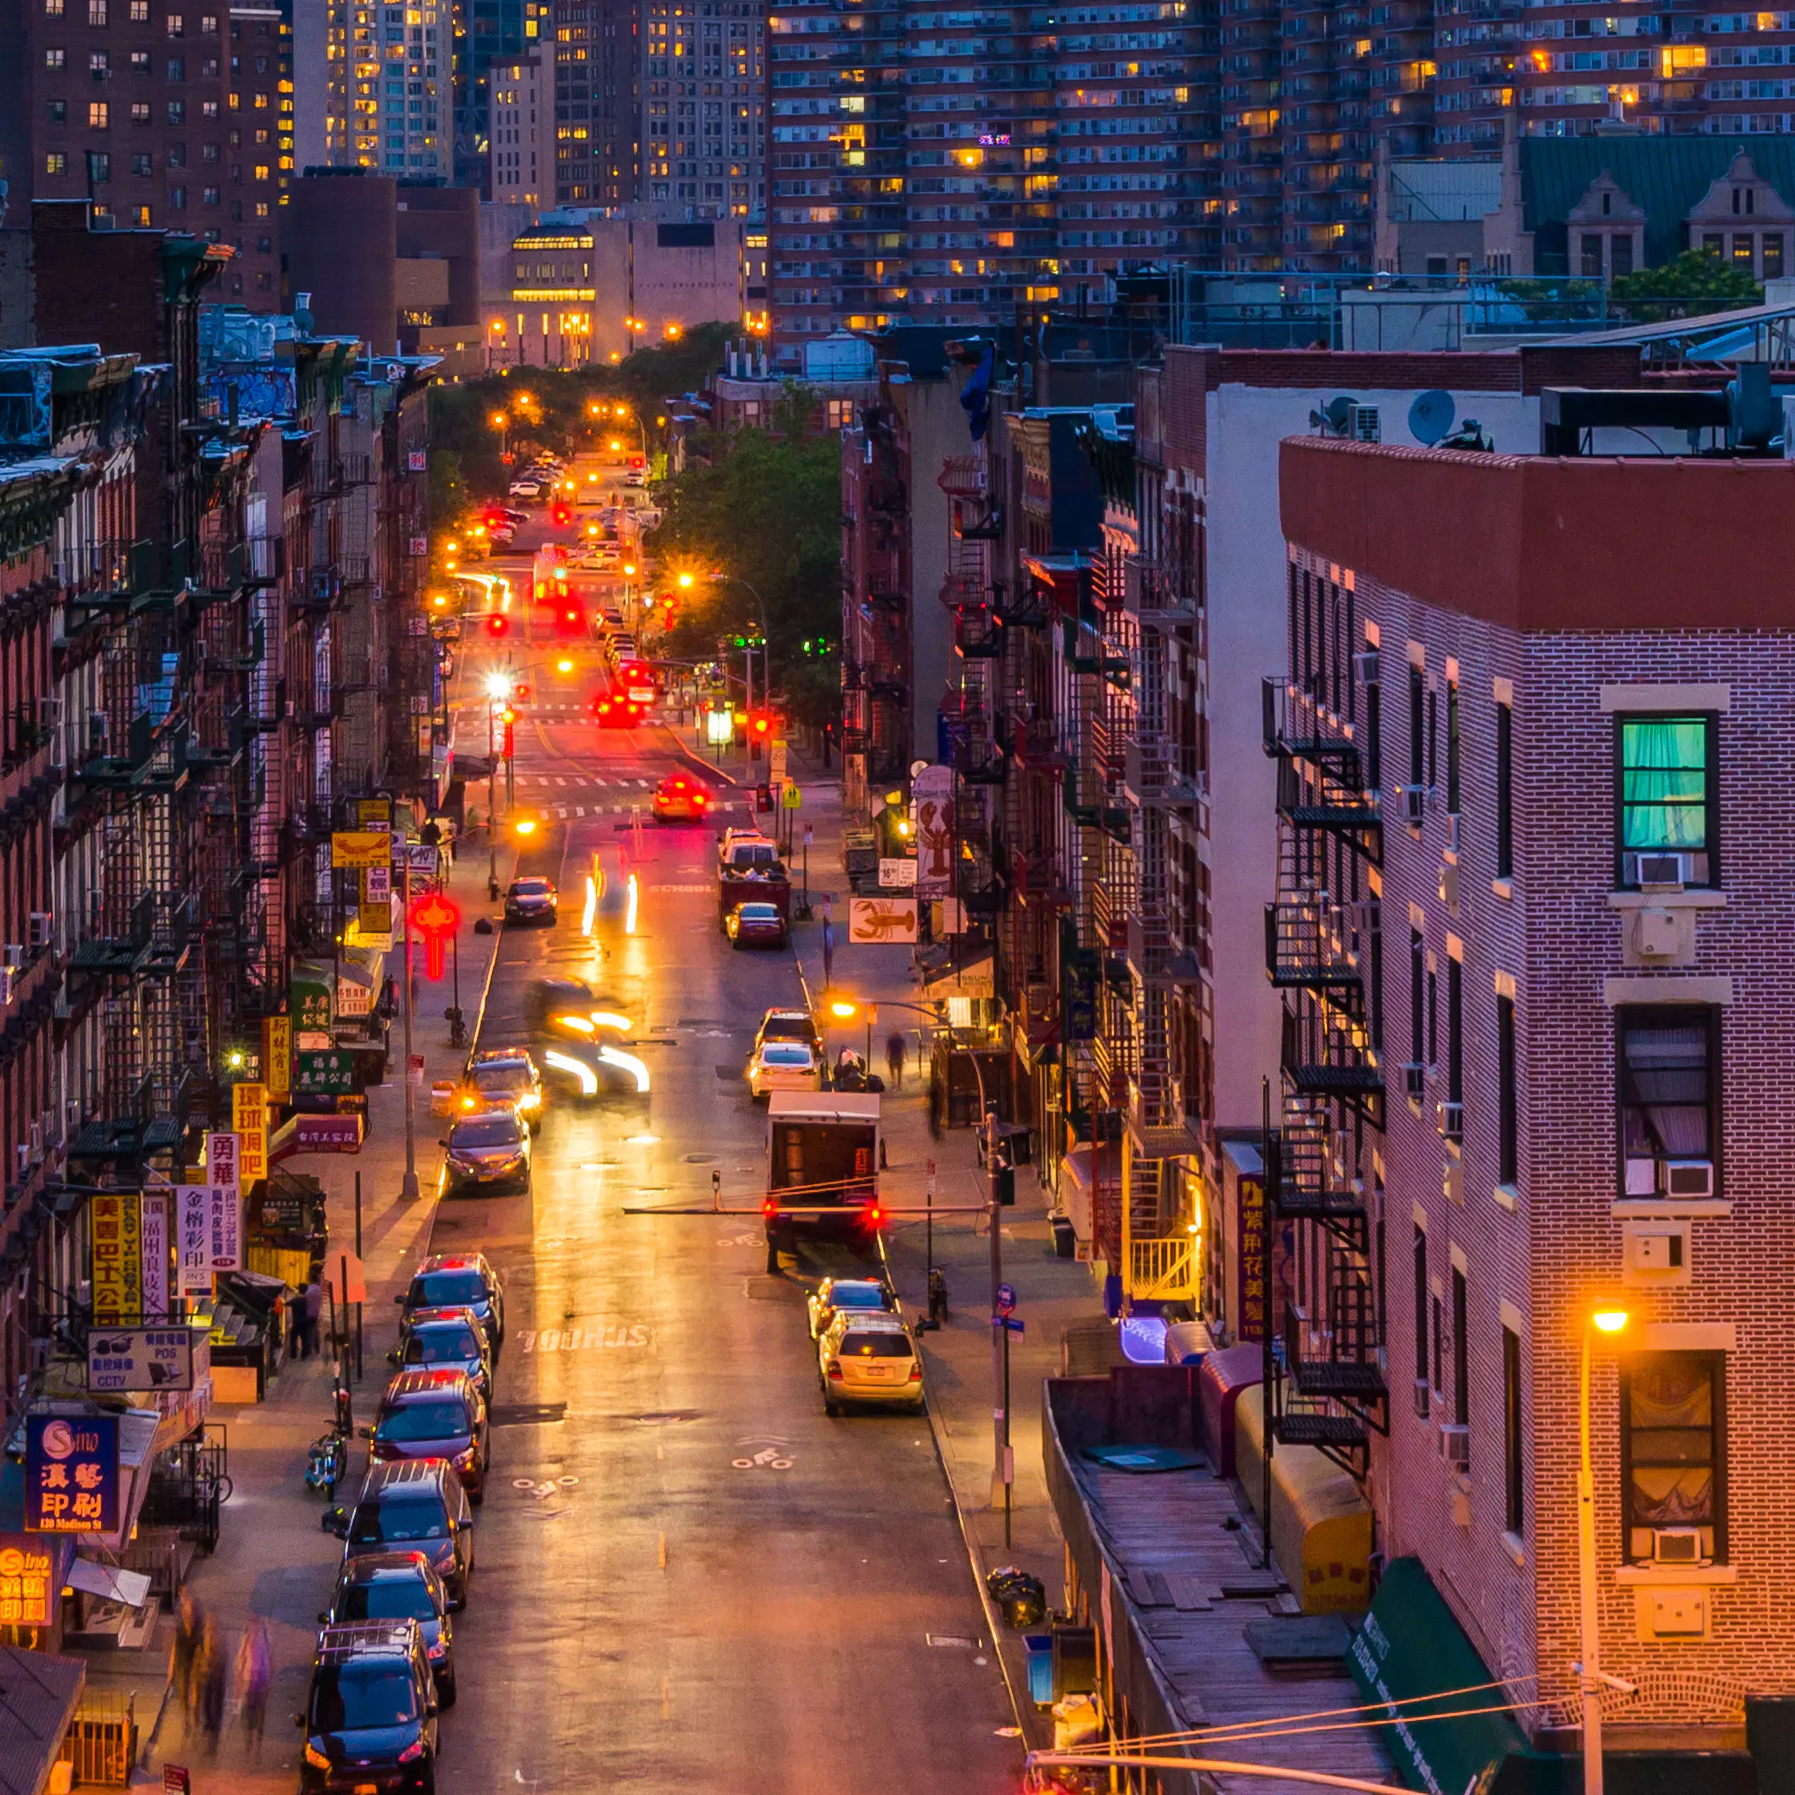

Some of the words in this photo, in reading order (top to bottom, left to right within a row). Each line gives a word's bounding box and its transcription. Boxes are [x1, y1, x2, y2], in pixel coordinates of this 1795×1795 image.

[648, 885, 712, 893] SCHOOL
[155, 1348, 177, 1359] POS
[97, 1375, 126, 1387] CCTV
[42, 1492, 102, 1518] 印刷
[56, 1517, 91, 1530] Madison
